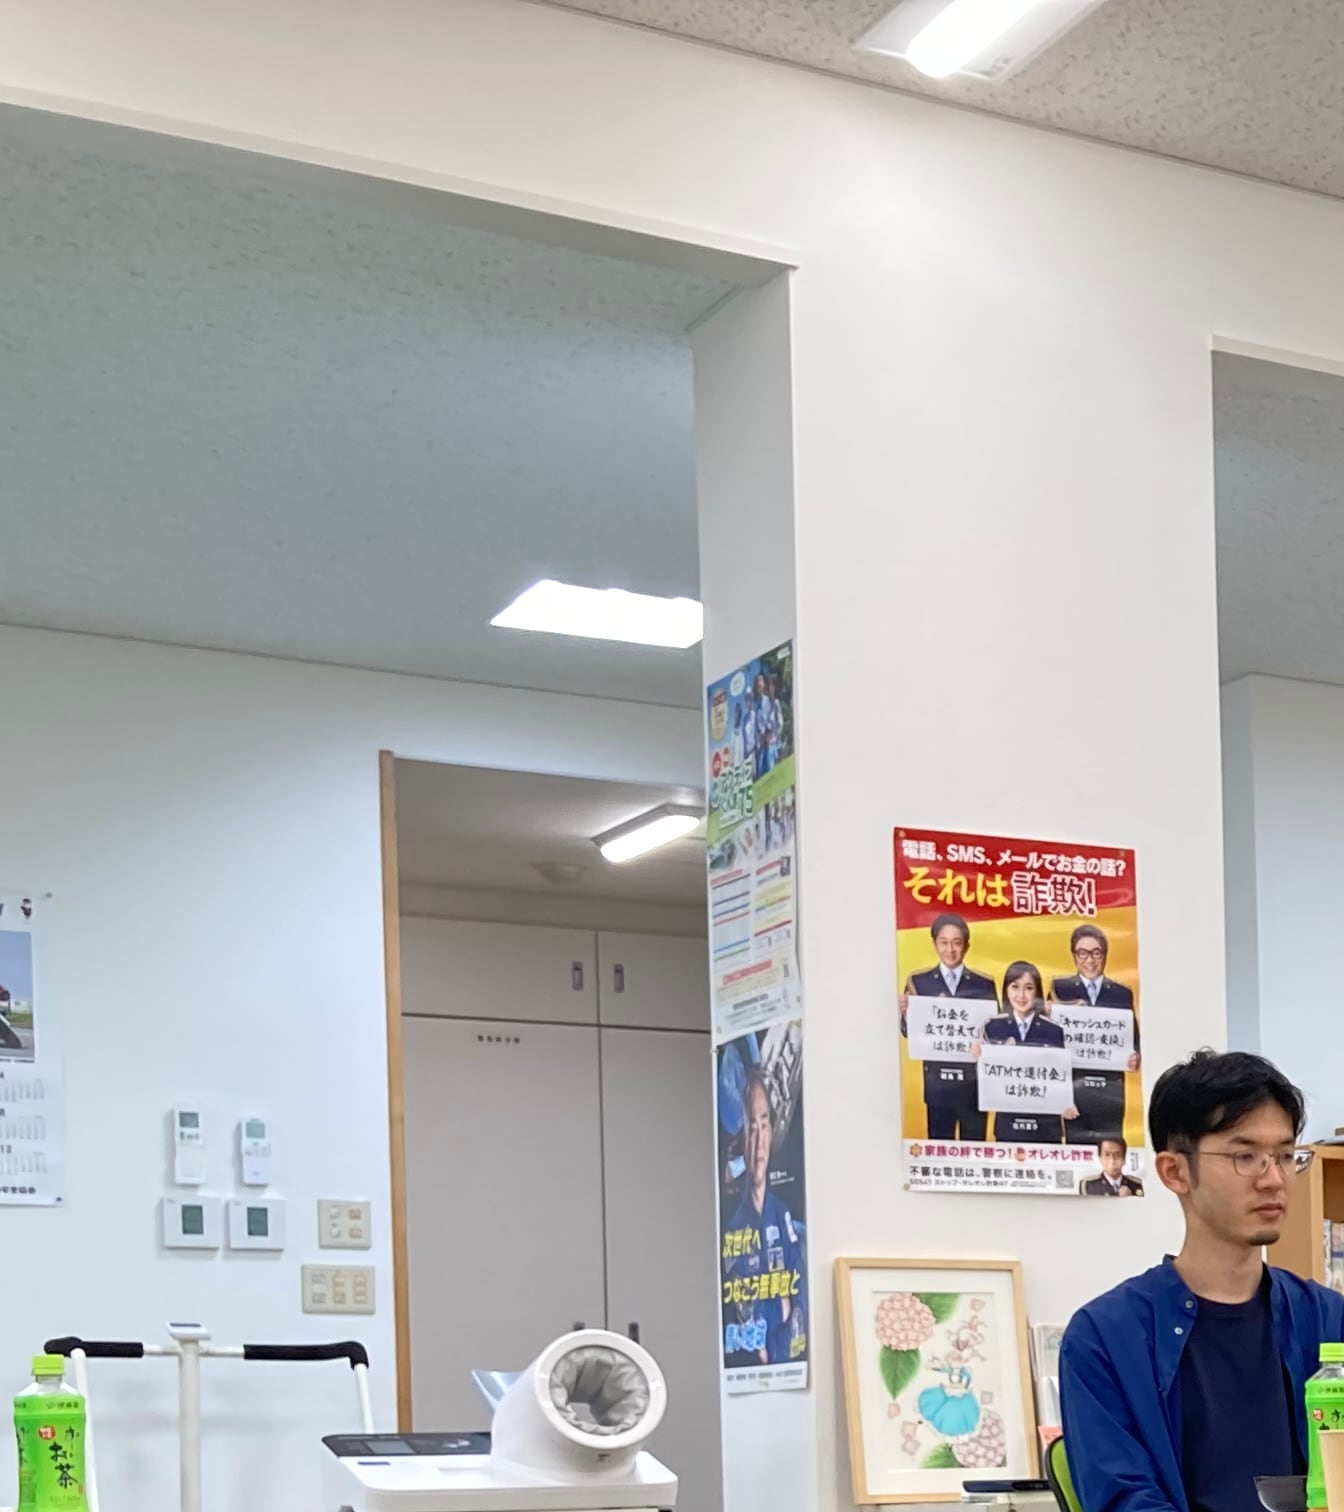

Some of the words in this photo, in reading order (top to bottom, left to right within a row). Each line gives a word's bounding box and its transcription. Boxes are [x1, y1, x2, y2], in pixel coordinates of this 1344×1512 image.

[902, 839, 1127, 877] 電話、SMS、メールでお金の話？
[904, 866, 1097, 916] それは詐欺！
[1028, 1149, 1094, 1162] オレオレ詐欺
[909, 1165, 1053, 1180] 不審な電話は、警察に連絡を。
